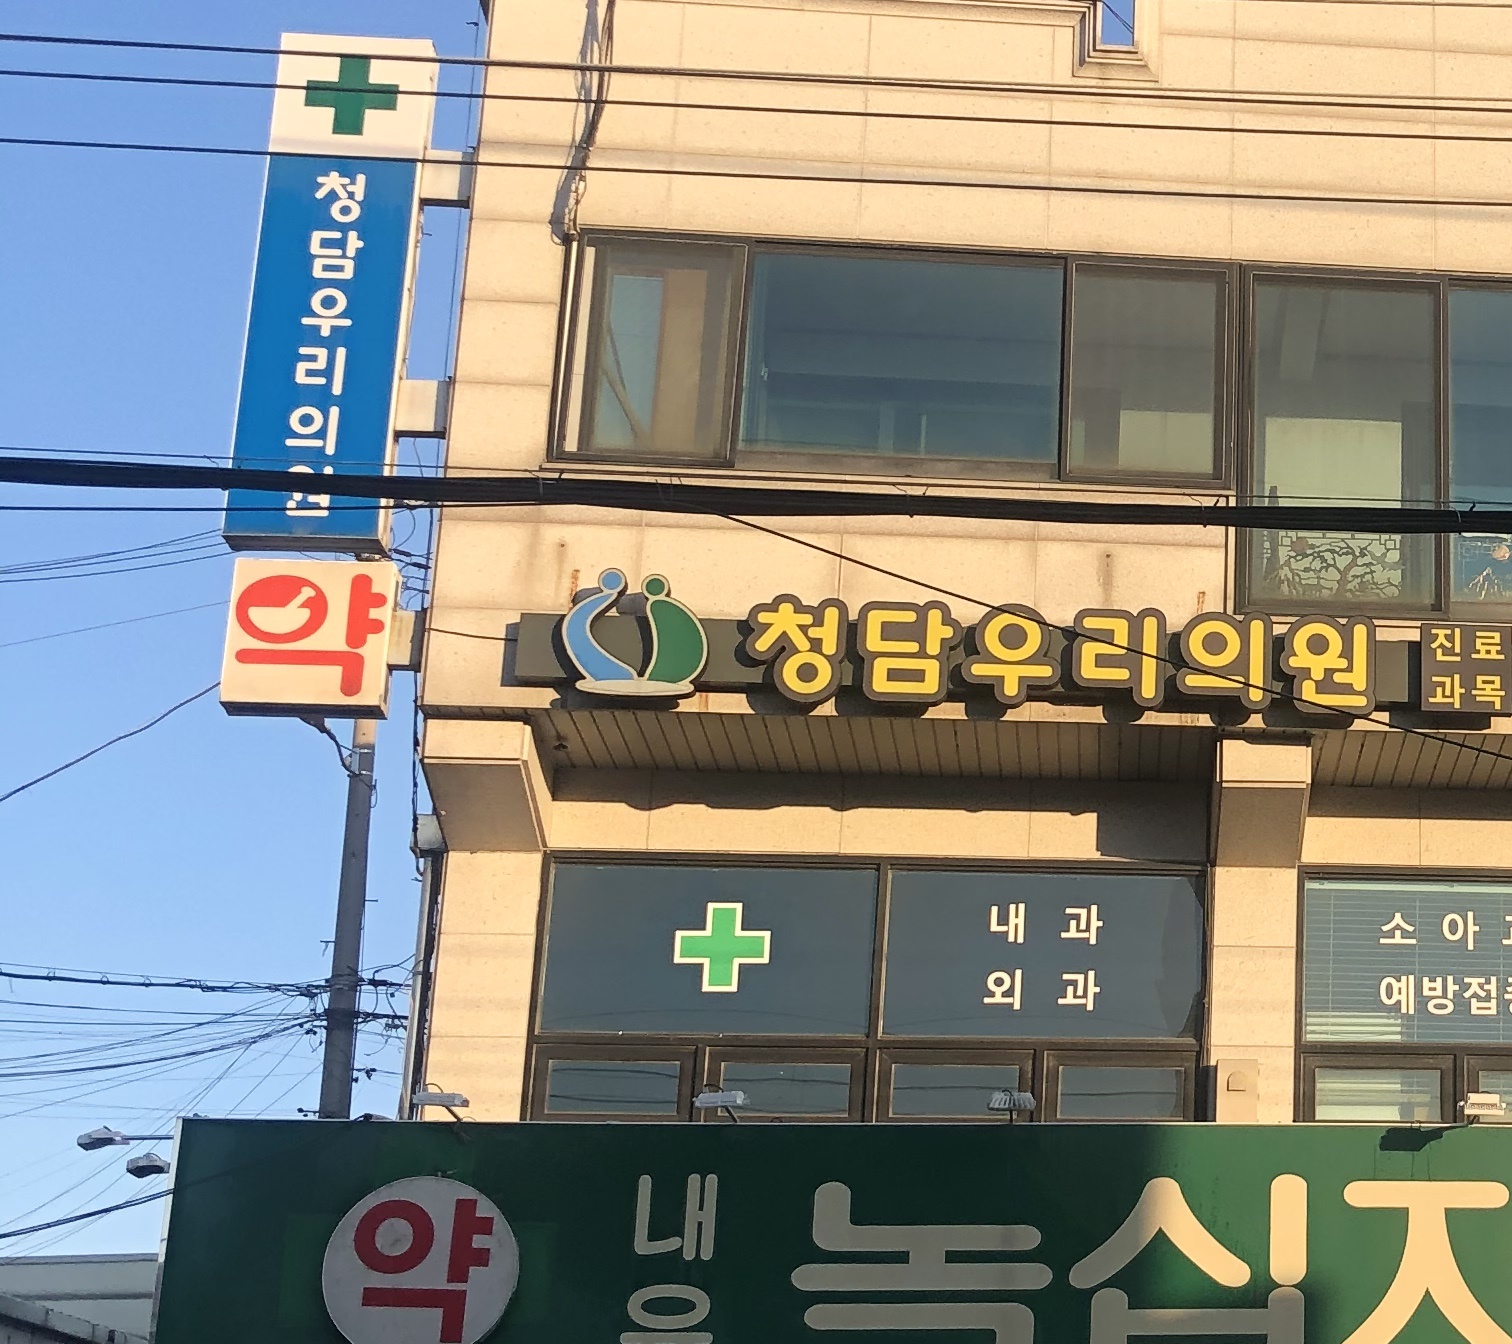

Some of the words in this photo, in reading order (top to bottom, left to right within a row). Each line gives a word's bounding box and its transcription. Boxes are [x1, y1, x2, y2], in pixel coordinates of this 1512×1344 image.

[234, 573, 388, 698] 약
[752, 598, 1373, 712] 청담우리의원
[1428, 672, 1507, 711] 과목
[1429, 627, 1507, 662] 진료
[353, 1197, 494, 1344] 약
